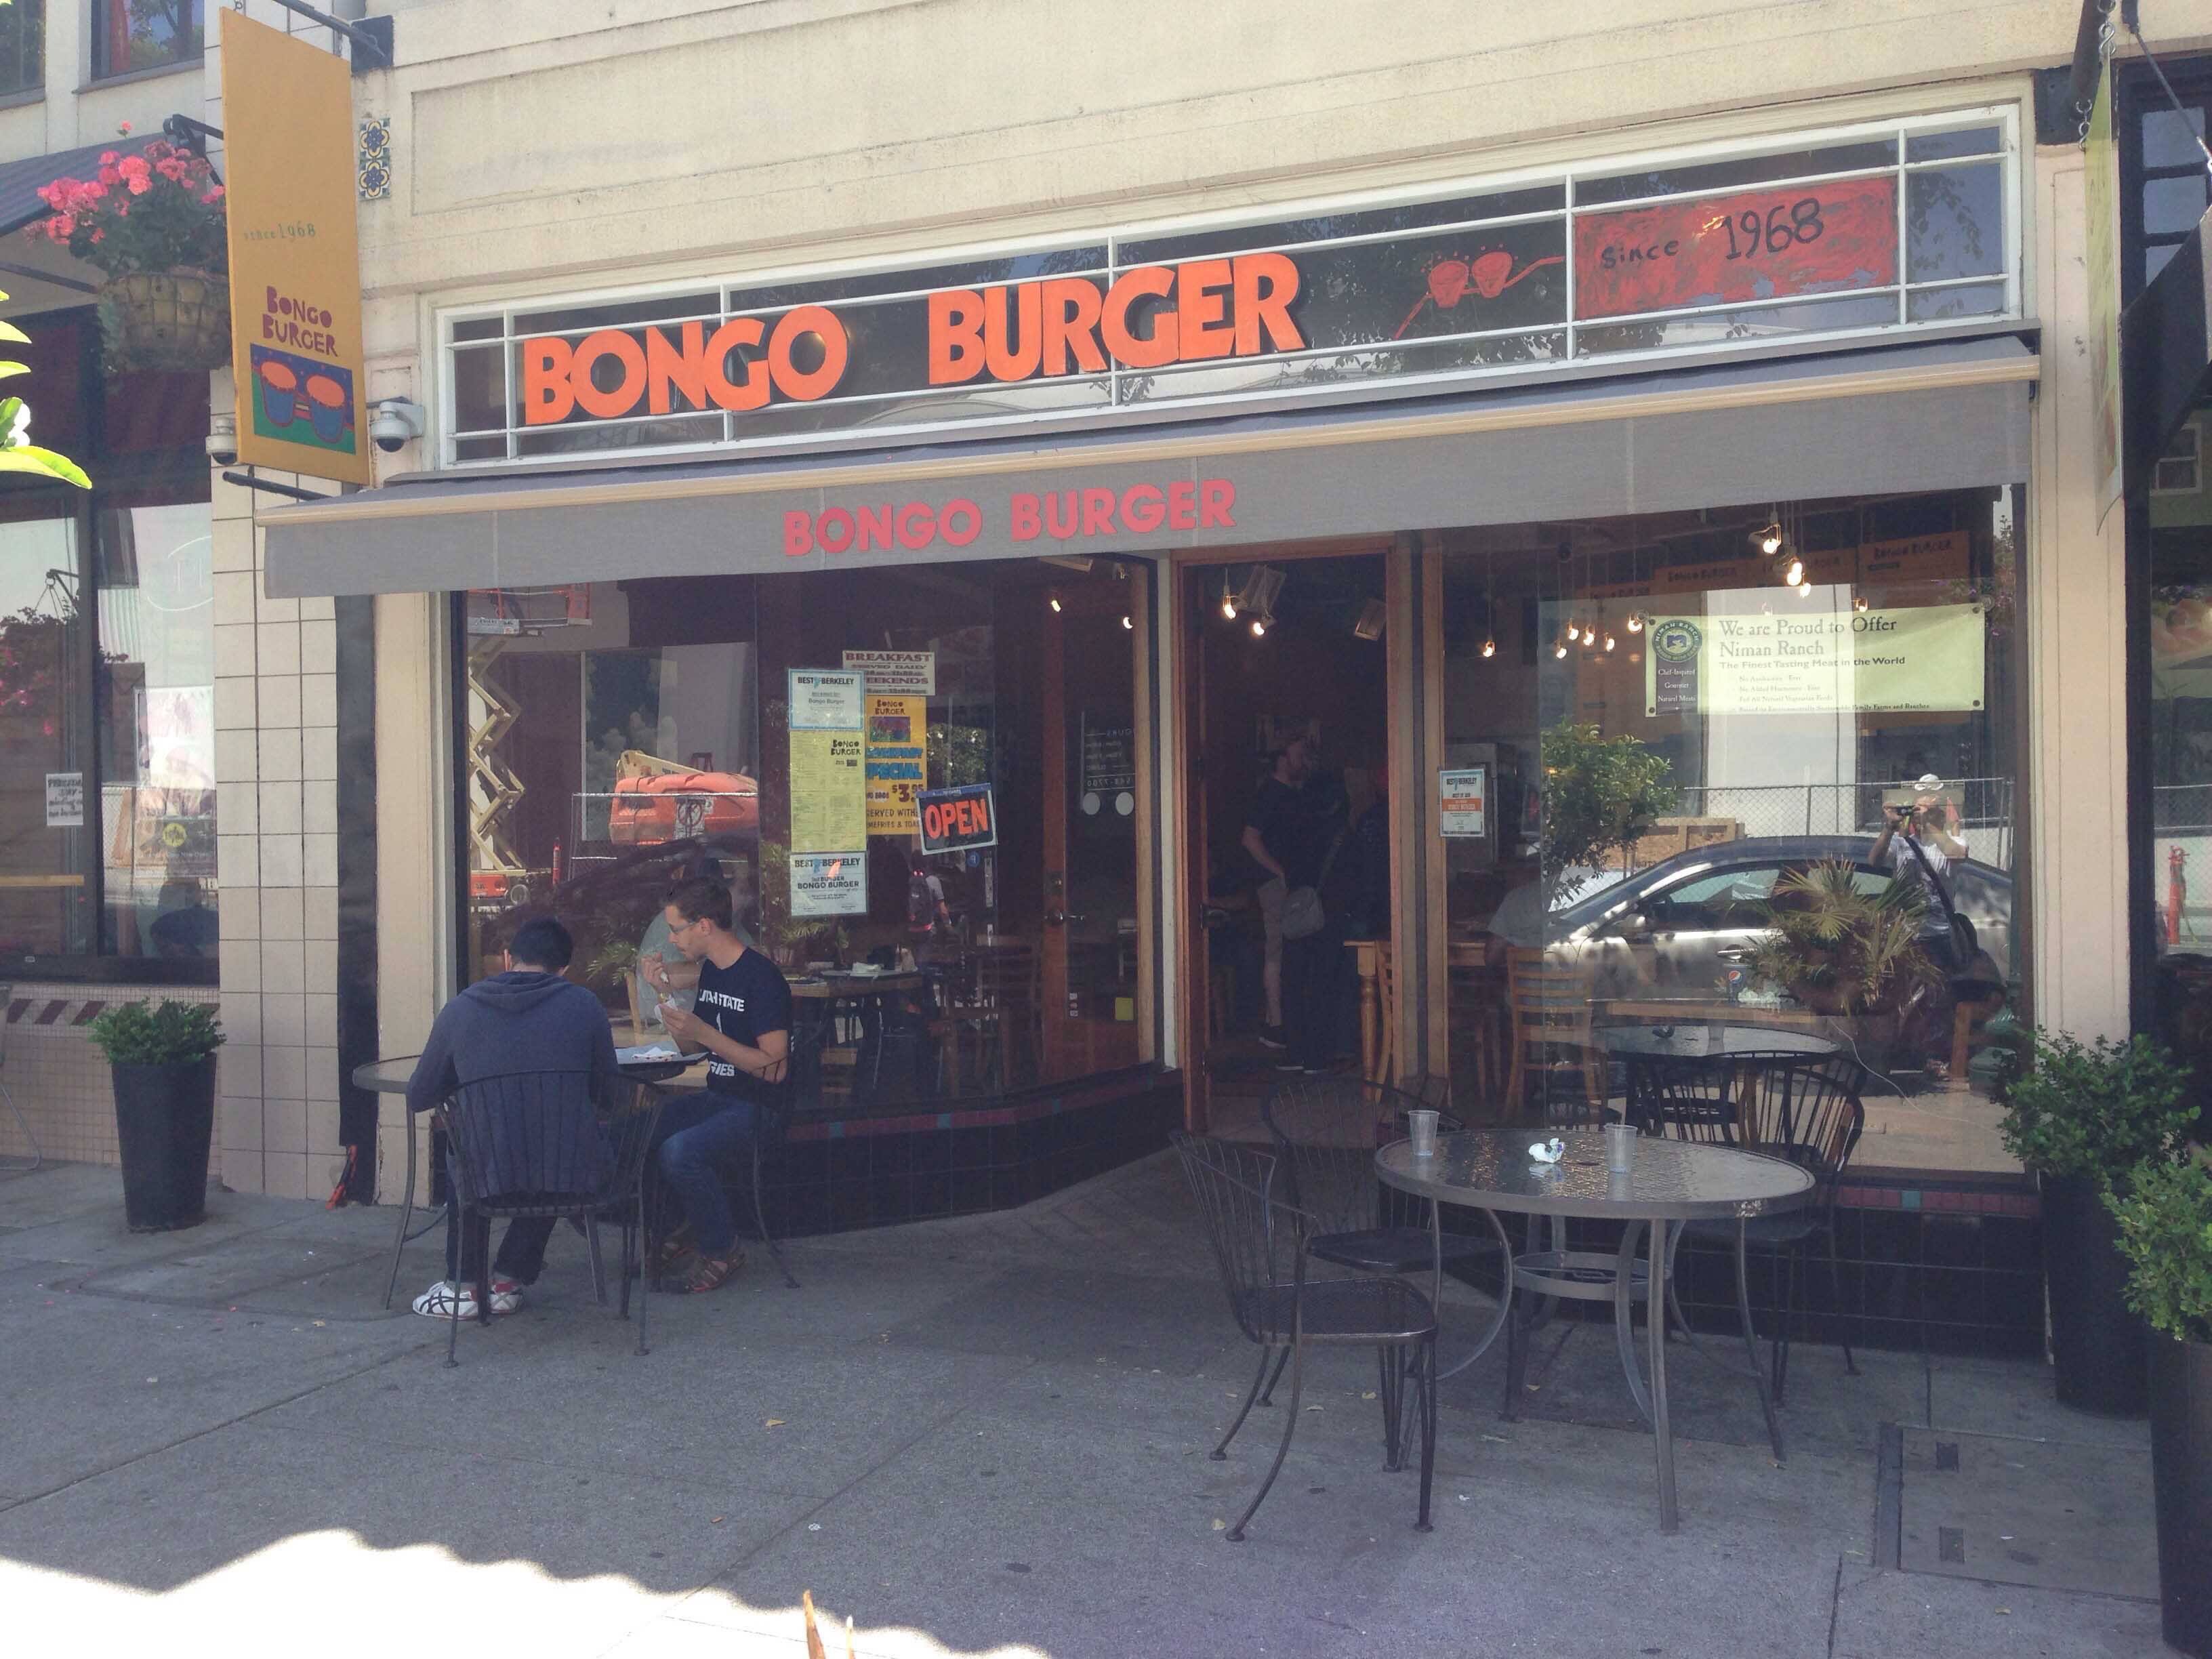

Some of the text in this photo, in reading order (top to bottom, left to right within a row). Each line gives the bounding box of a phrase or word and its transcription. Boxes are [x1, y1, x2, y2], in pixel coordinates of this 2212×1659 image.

[1721, 198, 1824, 260] 1968
[267, 285, 332, 328] BONGO
[262, 314, 338, 357] BURGER
[524, 253, 1307, 425] BONGO BURGER
[783, 479, 1236, 556] BONGO BURGER
[1719, 615, 1897, 636] We are Proud to Offer
[845, 653, 930, 662] BREAKFAST
[1719, 640, 1824, 657] Niman Ranch
[1774, 661, 1809, 670] Tasting
[1812, 658, 1838, 668] Meat
[1841, 658, 1850, 666] in
[1872, 657, 1906, 665] World
[832, 739, 860, 747] BONGO
[867, 763, 922, 779] PECIAL
[925, 798, 988, 840] OPEN
[795, 859, 813, 867] BEST
